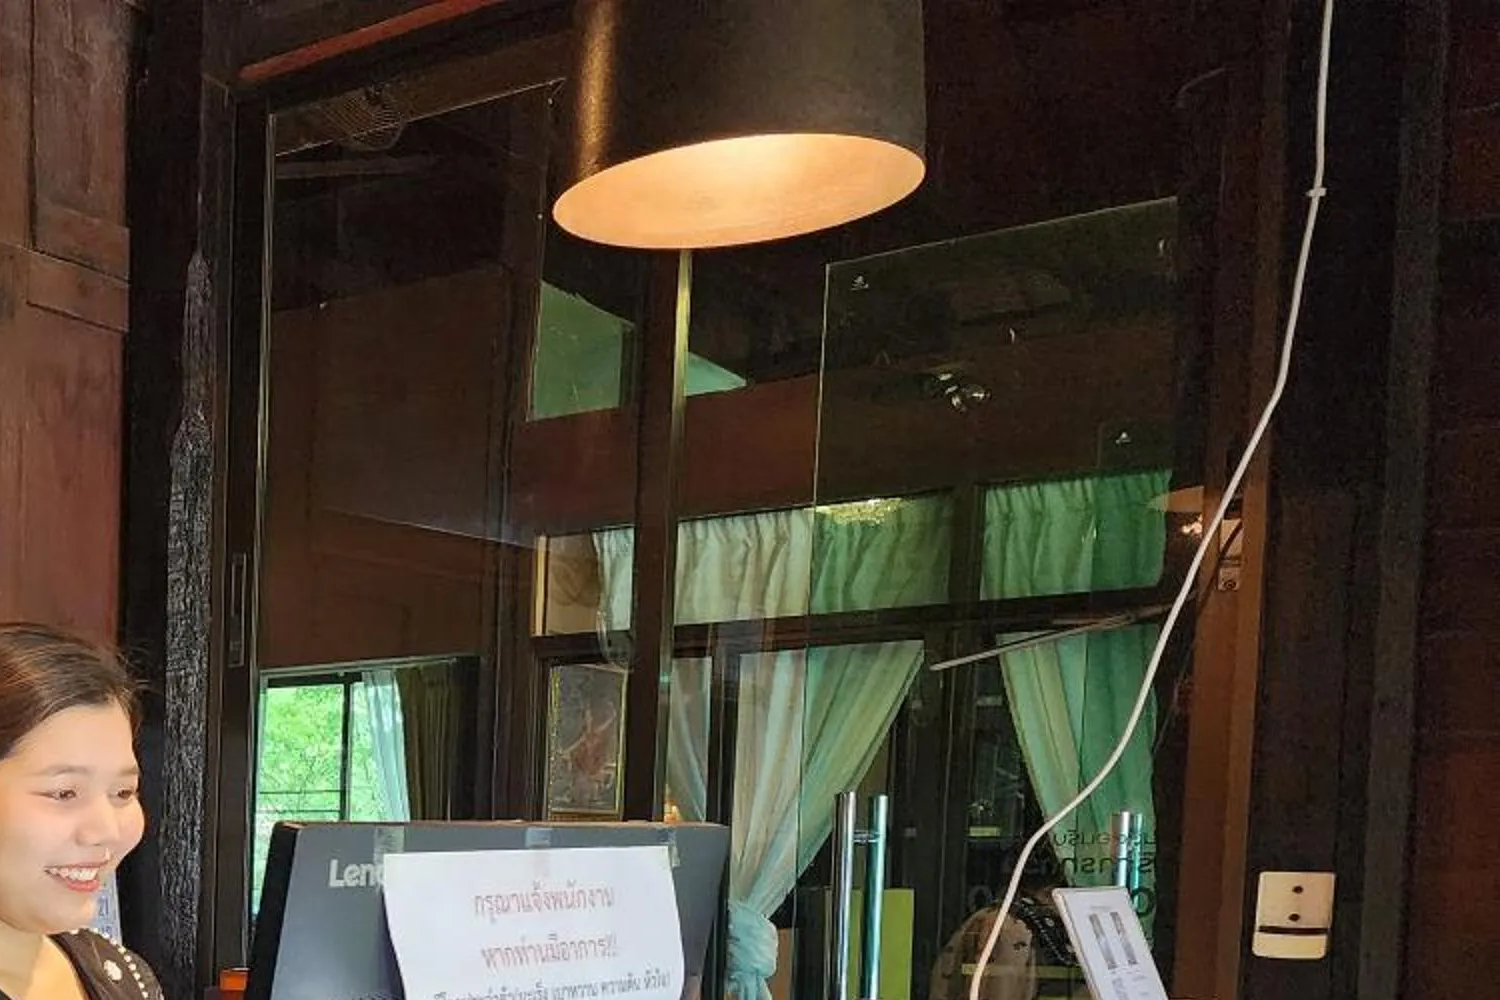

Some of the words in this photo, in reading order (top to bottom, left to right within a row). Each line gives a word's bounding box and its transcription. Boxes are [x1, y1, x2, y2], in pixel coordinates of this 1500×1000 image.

[474, 879, 615, 923] กรุณาแจ้งพนักงาน
